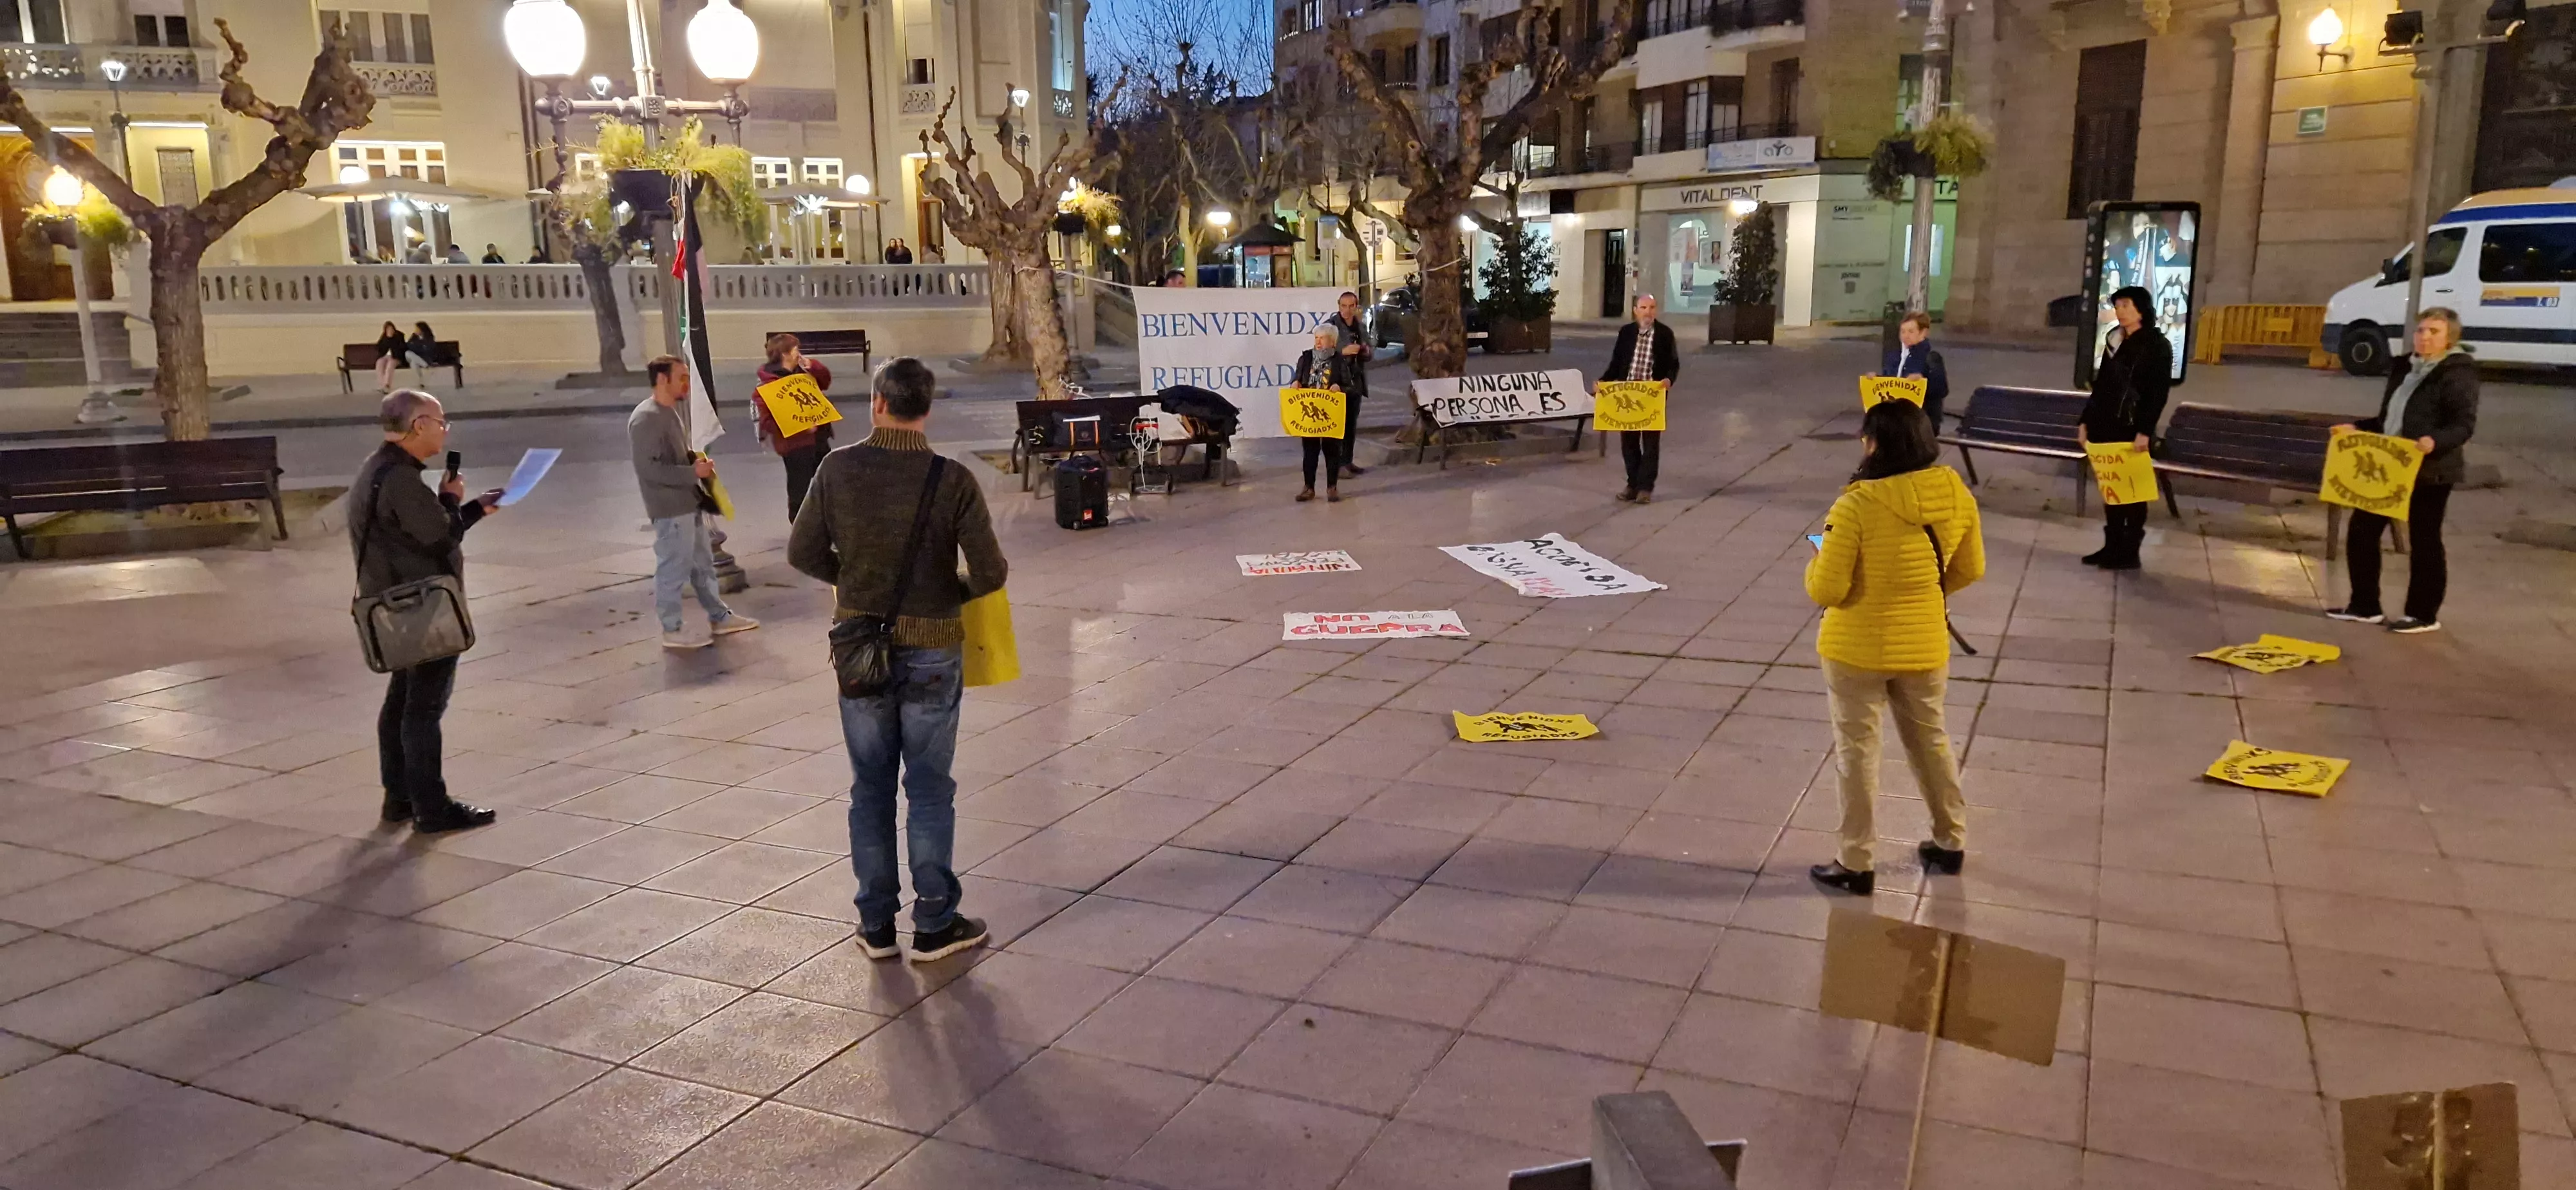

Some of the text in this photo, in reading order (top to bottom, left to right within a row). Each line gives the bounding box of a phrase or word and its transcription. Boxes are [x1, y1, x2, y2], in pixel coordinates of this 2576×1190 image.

[1459, 372, 1553, 393] NINGUNA
[1288, 392, 1340, 406] BIENVENIDXS
[1434, 393, 1524, 417] PERSONA
[1540, 392, 1566, 411] ES
[1290, 420, 1338, 434] REFUGIADXS
[1314, 614, 1370, 623] NO
[1473, 715, 1573, 726] BIENVENIDXS
[1481, 731, 1579, 739] REFUGIADXS
